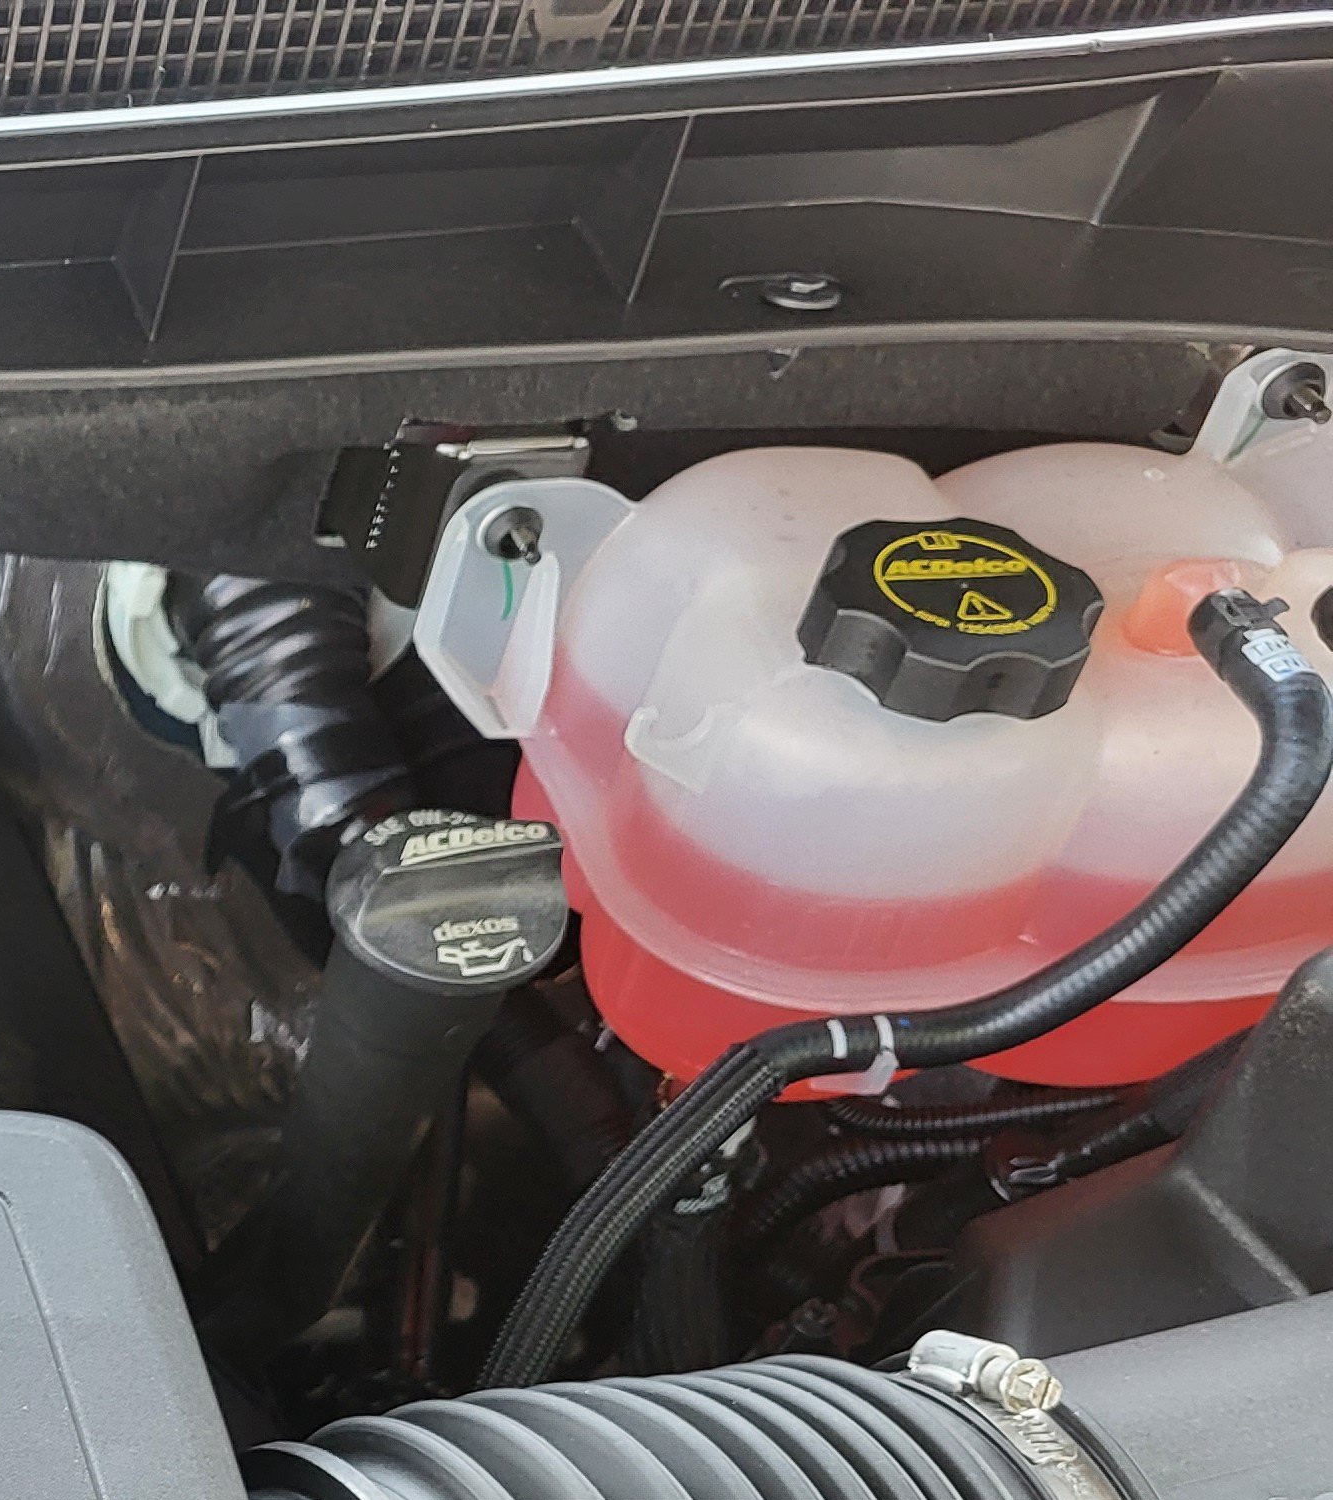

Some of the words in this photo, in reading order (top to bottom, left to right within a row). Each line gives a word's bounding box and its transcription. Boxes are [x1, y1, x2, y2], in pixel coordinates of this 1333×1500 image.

[885, 557, 1028, 576] ACDelco
[400, 821, 549, 861] ACDelco
[433, 916, 520, 942] dexos
